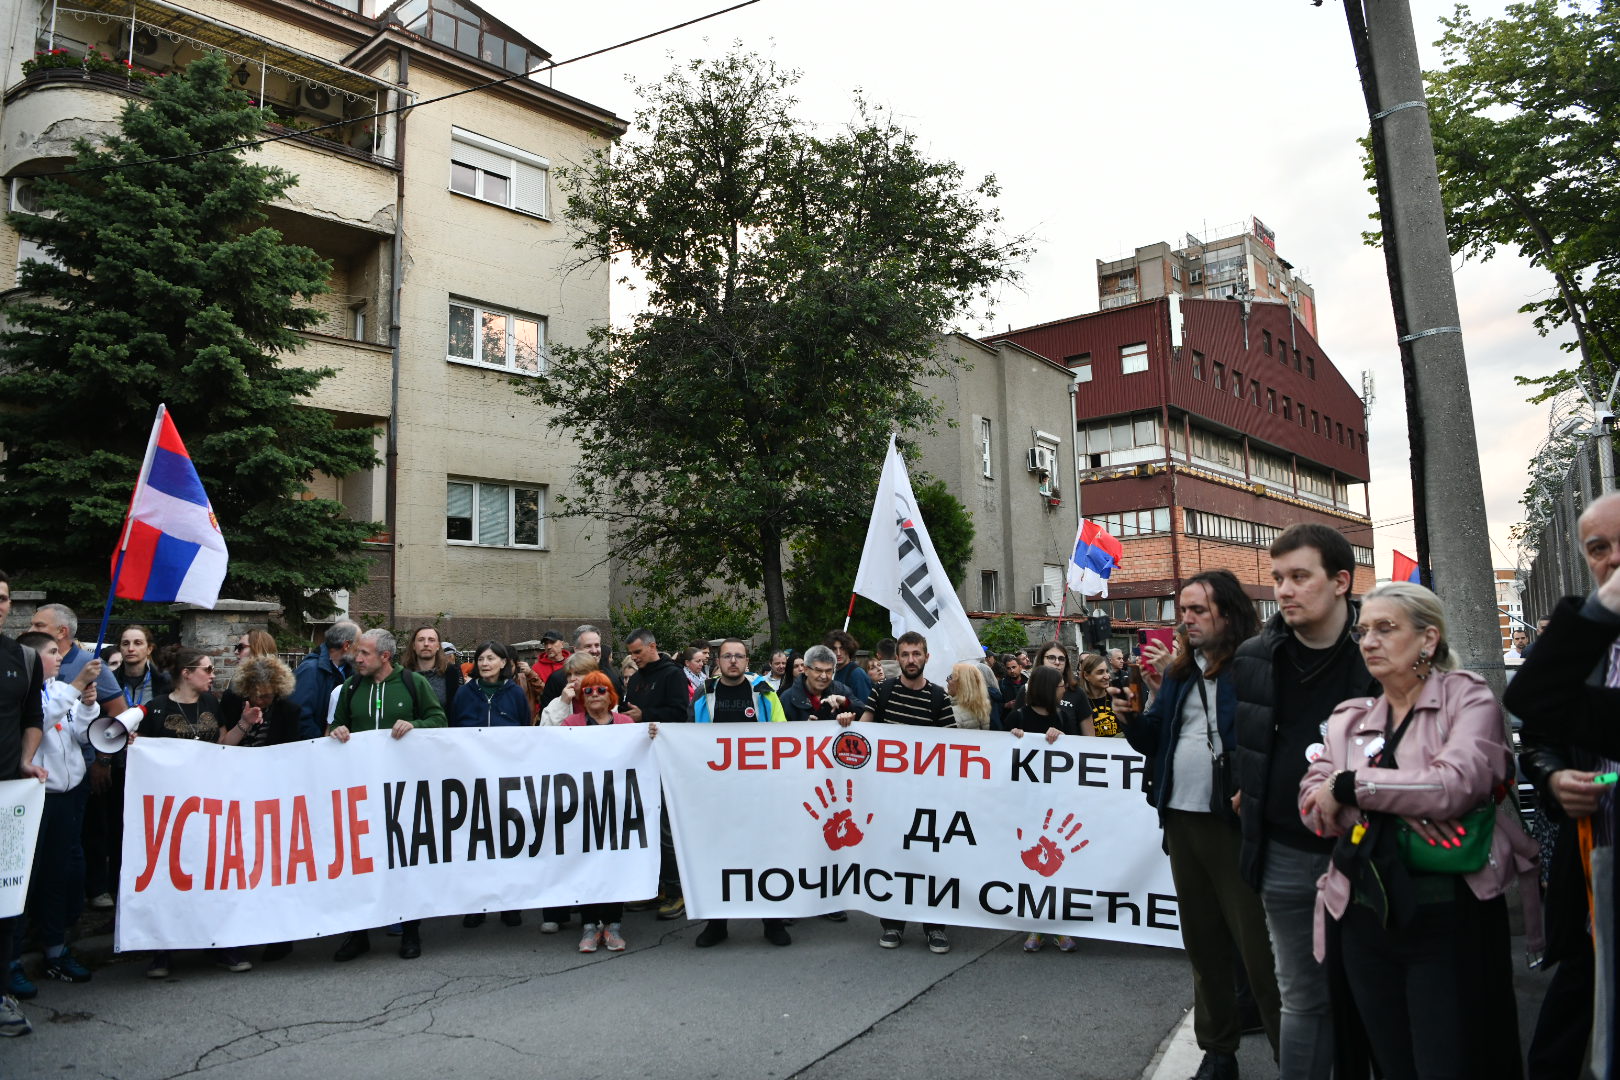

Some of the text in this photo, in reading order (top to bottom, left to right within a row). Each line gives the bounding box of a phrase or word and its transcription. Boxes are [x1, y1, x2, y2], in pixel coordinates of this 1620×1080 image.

[135, 768, 648, 892] УСТАЛА ЈЕ КАРАБУРМА
[902, 808, 977, 852] ДА
[721, 863, 1180, 931] ПОЧИСТИ СМЕЋЕ
